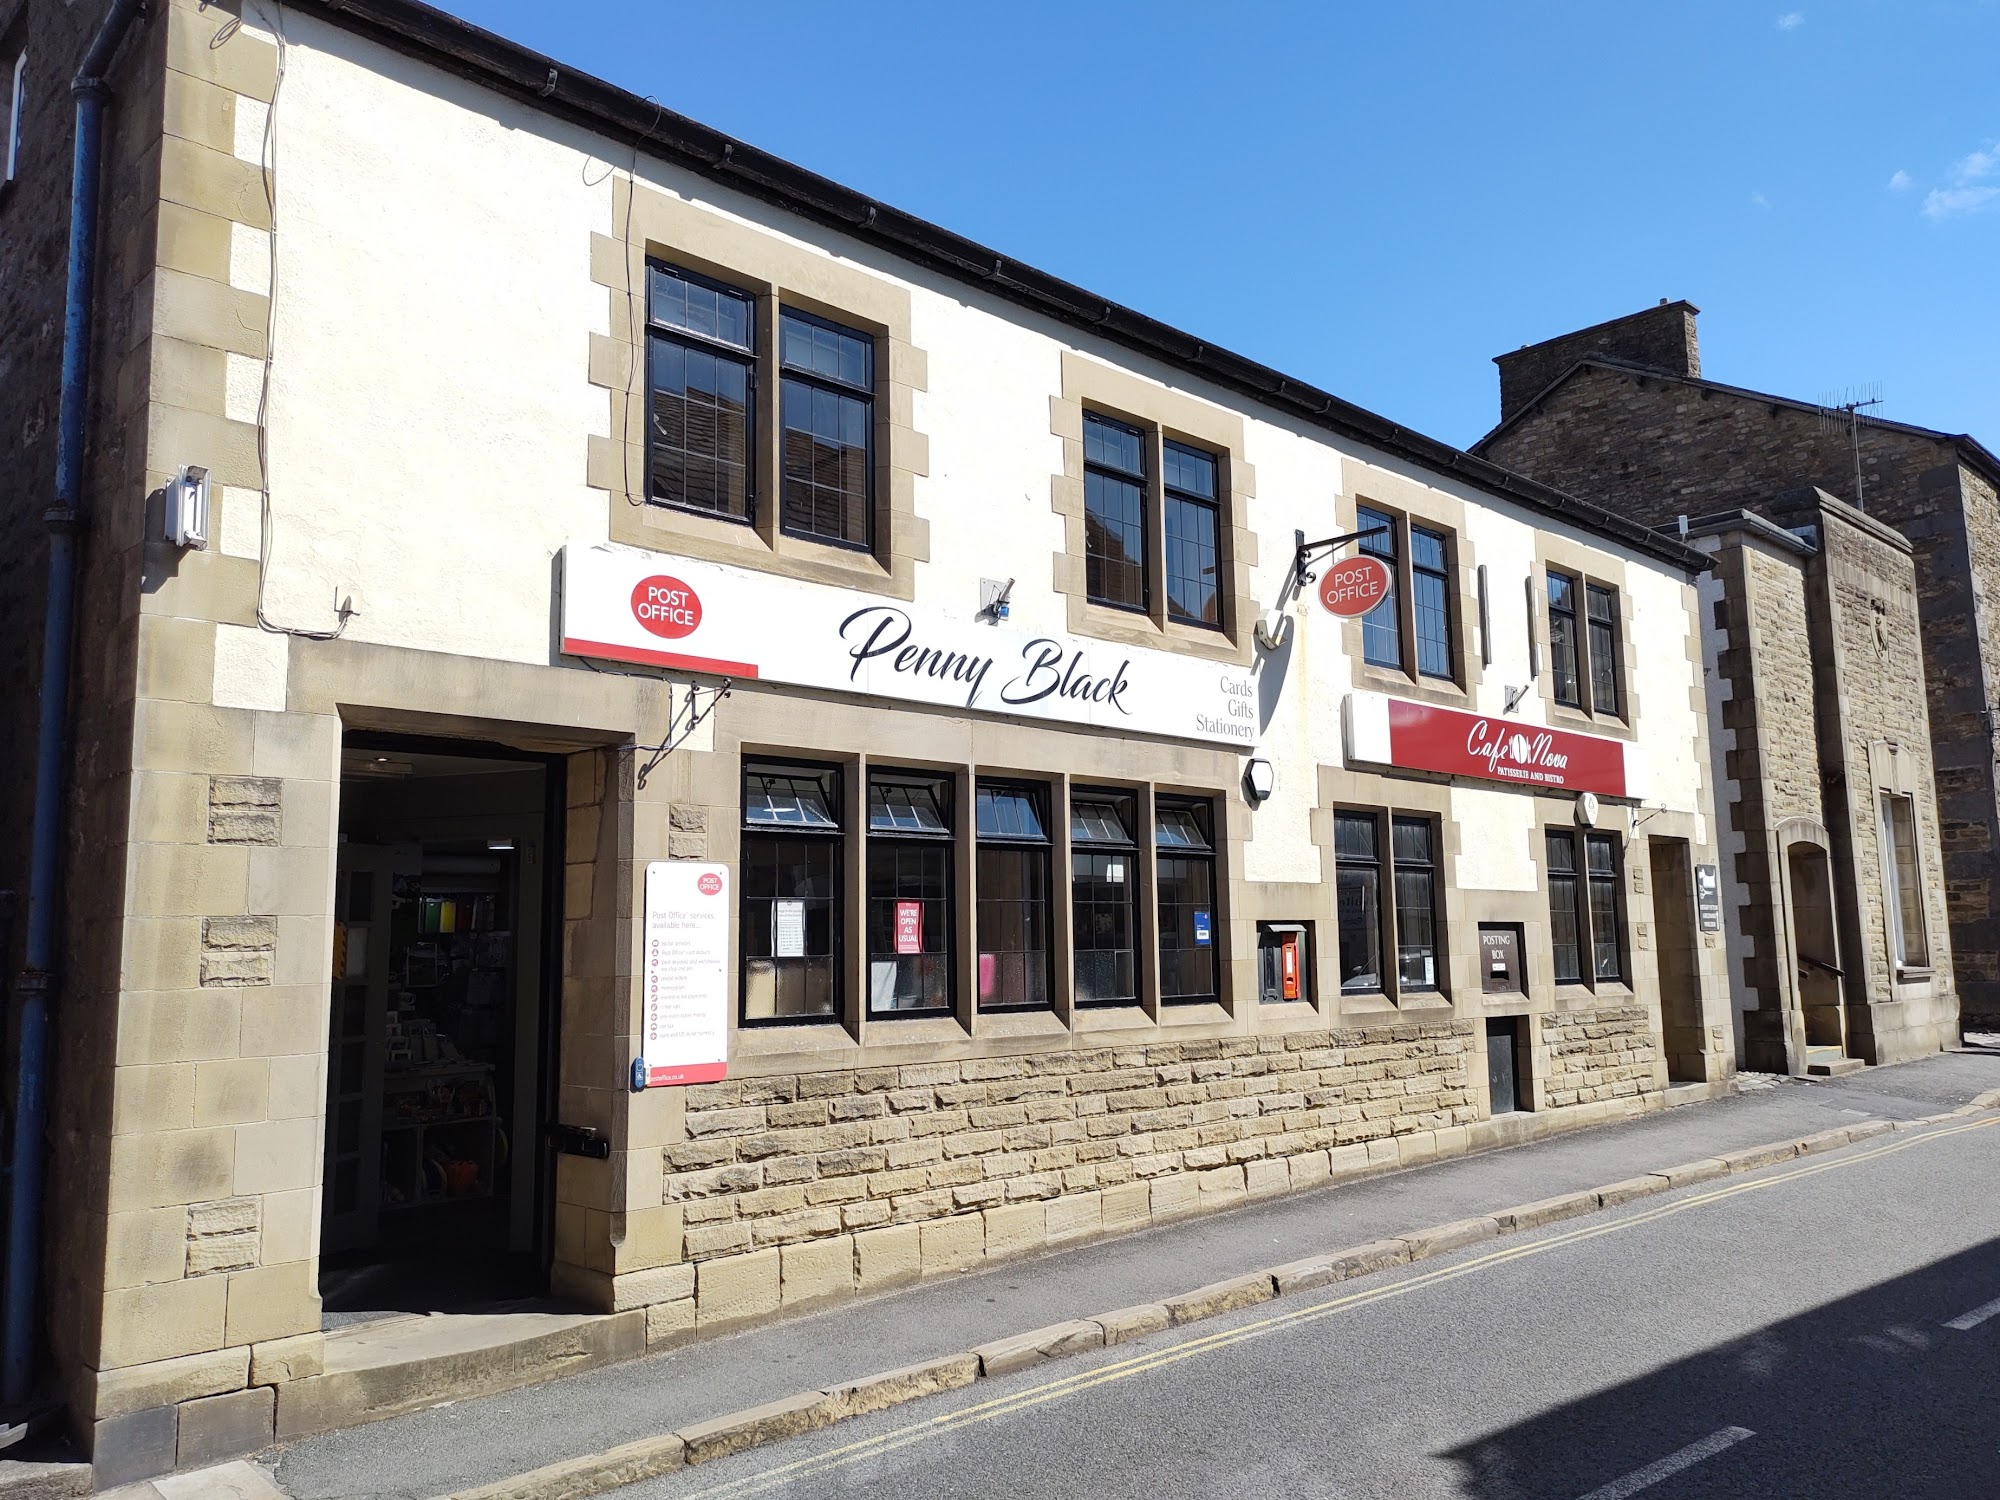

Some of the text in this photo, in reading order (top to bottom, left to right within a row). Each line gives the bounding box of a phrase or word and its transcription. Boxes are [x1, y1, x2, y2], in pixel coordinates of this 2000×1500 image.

[1335, 566, 1372, 587] POST
[648, 586, 689, 607] POST
[1326, 581, 1379, 604] OFFICE
[637, 602, 694, 626] OFFICE
[838, 606, 1134, 716] Penny Black
[1220, 676, 1253, 698] Cards
[1228, 699, 1254, 719] Gifts
[1196, 714, 1255, 742] Stationery
[1467, 719, 1569, 773] Cafe Nova
[1497, 766, 1565, 784] PATISSERIE AND BISTRO
[699, 883, 720, 891] OFFICE
[904, 926, 913, 934] AS
[1482, 935, 1510, 945] POSTING
[1491, 949, 1505, 959] BOX
